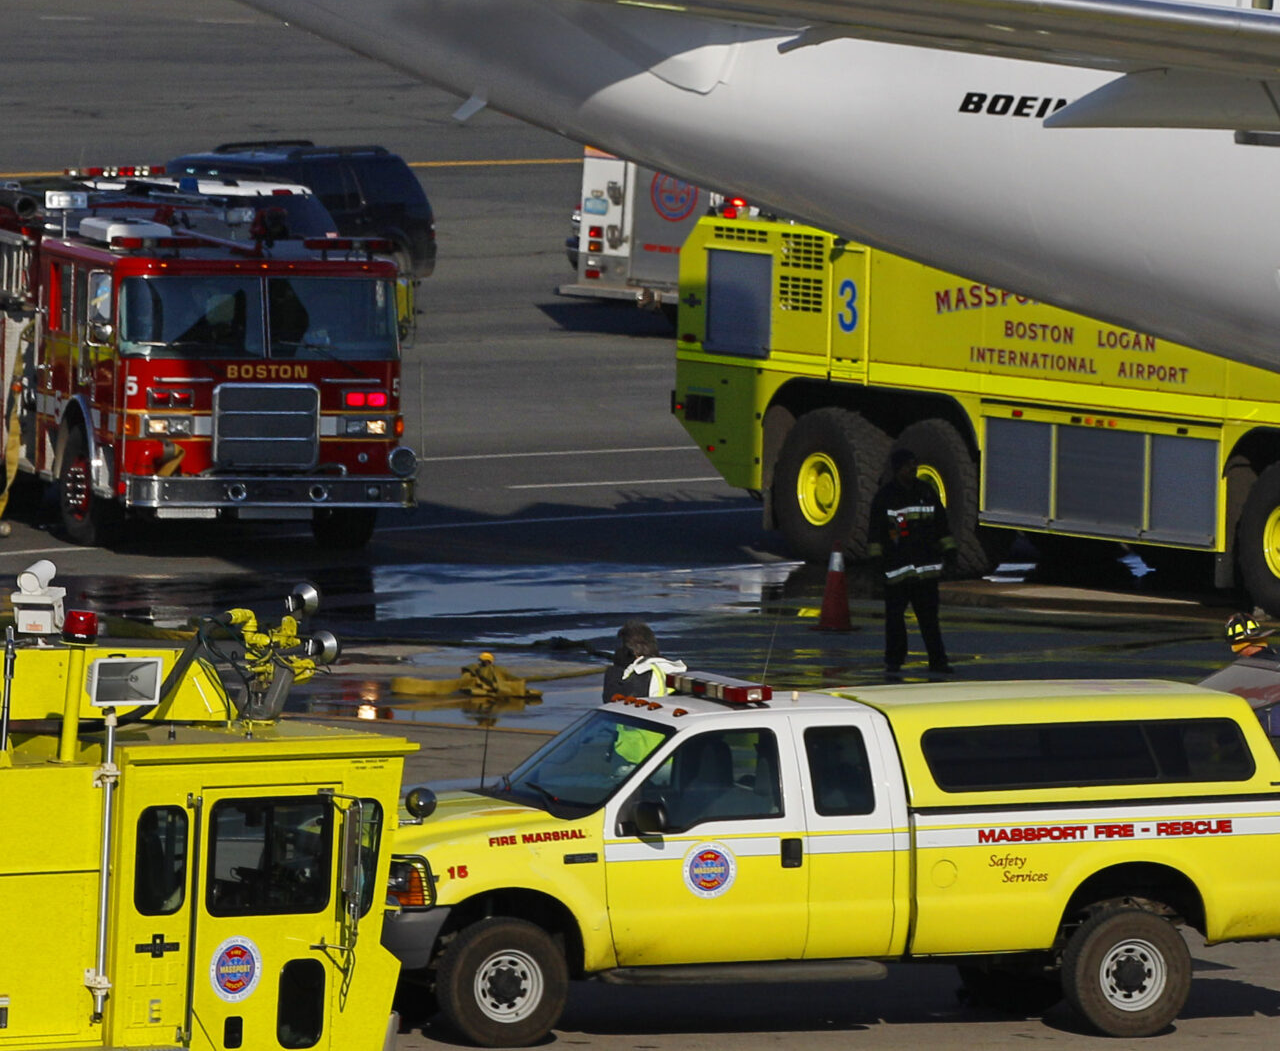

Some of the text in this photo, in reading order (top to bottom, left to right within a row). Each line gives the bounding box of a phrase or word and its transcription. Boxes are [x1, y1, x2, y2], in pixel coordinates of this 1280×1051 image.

[958, 92, 1067, 118] BOEI
[838, 279, 858, 333] 3
[935, 285, 1030, 314] MASSP
[1004, 320, 1157, 353] BOSTON LOGAN
[226, 364, 308, 379] BOSTON
[969, 346, 1189, 385] INTERNATIONAL AIRPORT
[126, 376, 138, 396] 5
[489, 829, 586, 847] FIRE MARSHAL
[978, 826, 1088, 844] MASSPORT
[1094, 824, 1134, 839] FIRE
[1156, 820, 1232, 837] RESCUE
[447, 865, 468, 879] 15
[988, 854, 1027, 869] Safety
[1002, 871, 1048, 883] Services
